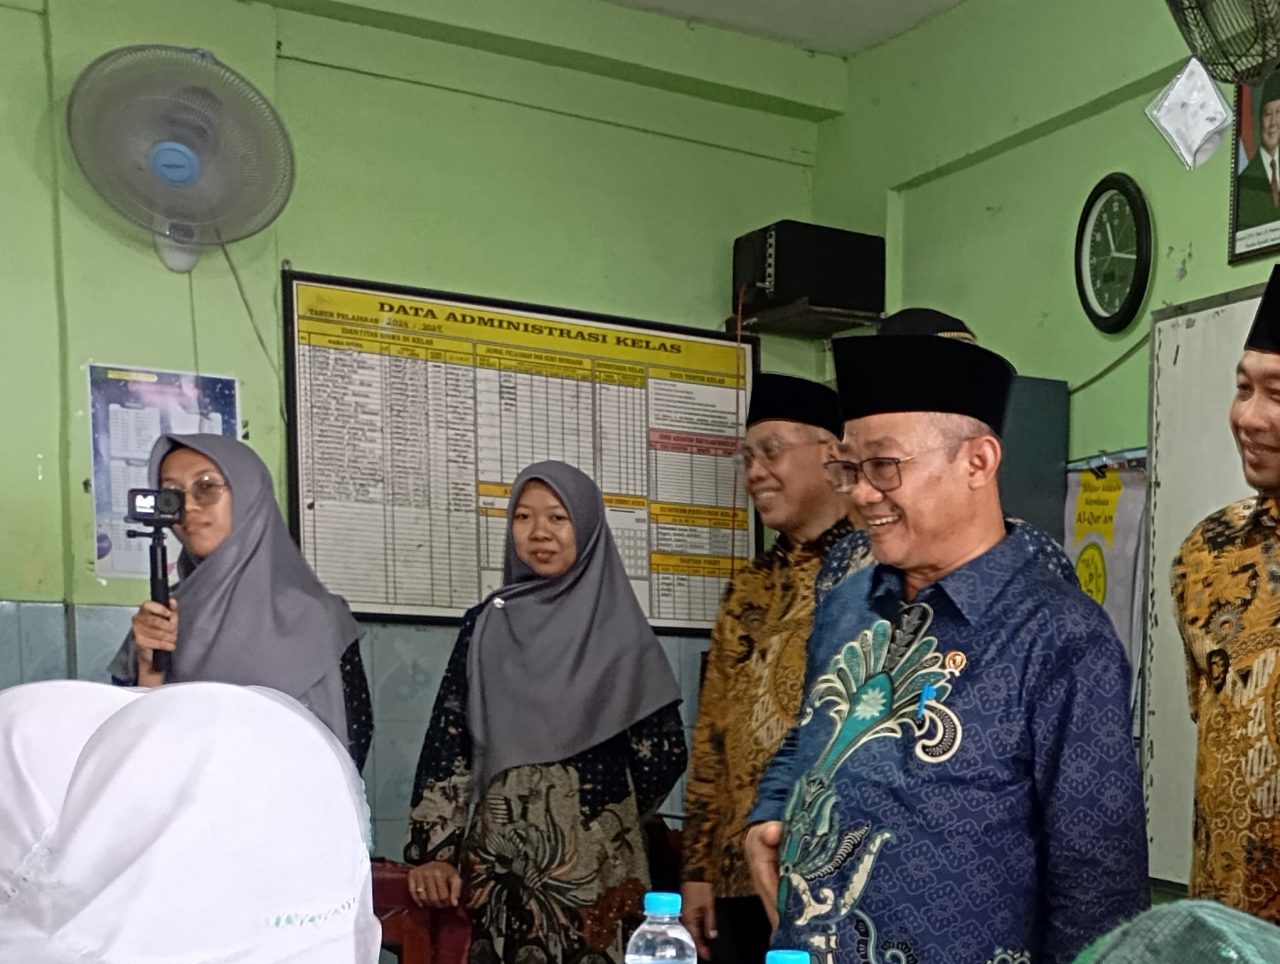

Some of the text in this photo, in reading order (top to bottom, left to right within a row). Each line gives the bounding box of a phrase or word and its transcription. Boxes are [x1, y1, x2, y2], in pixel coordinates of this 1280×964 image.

[379, 302, 683, 354] DATA ADMINISTRASI KELAS
